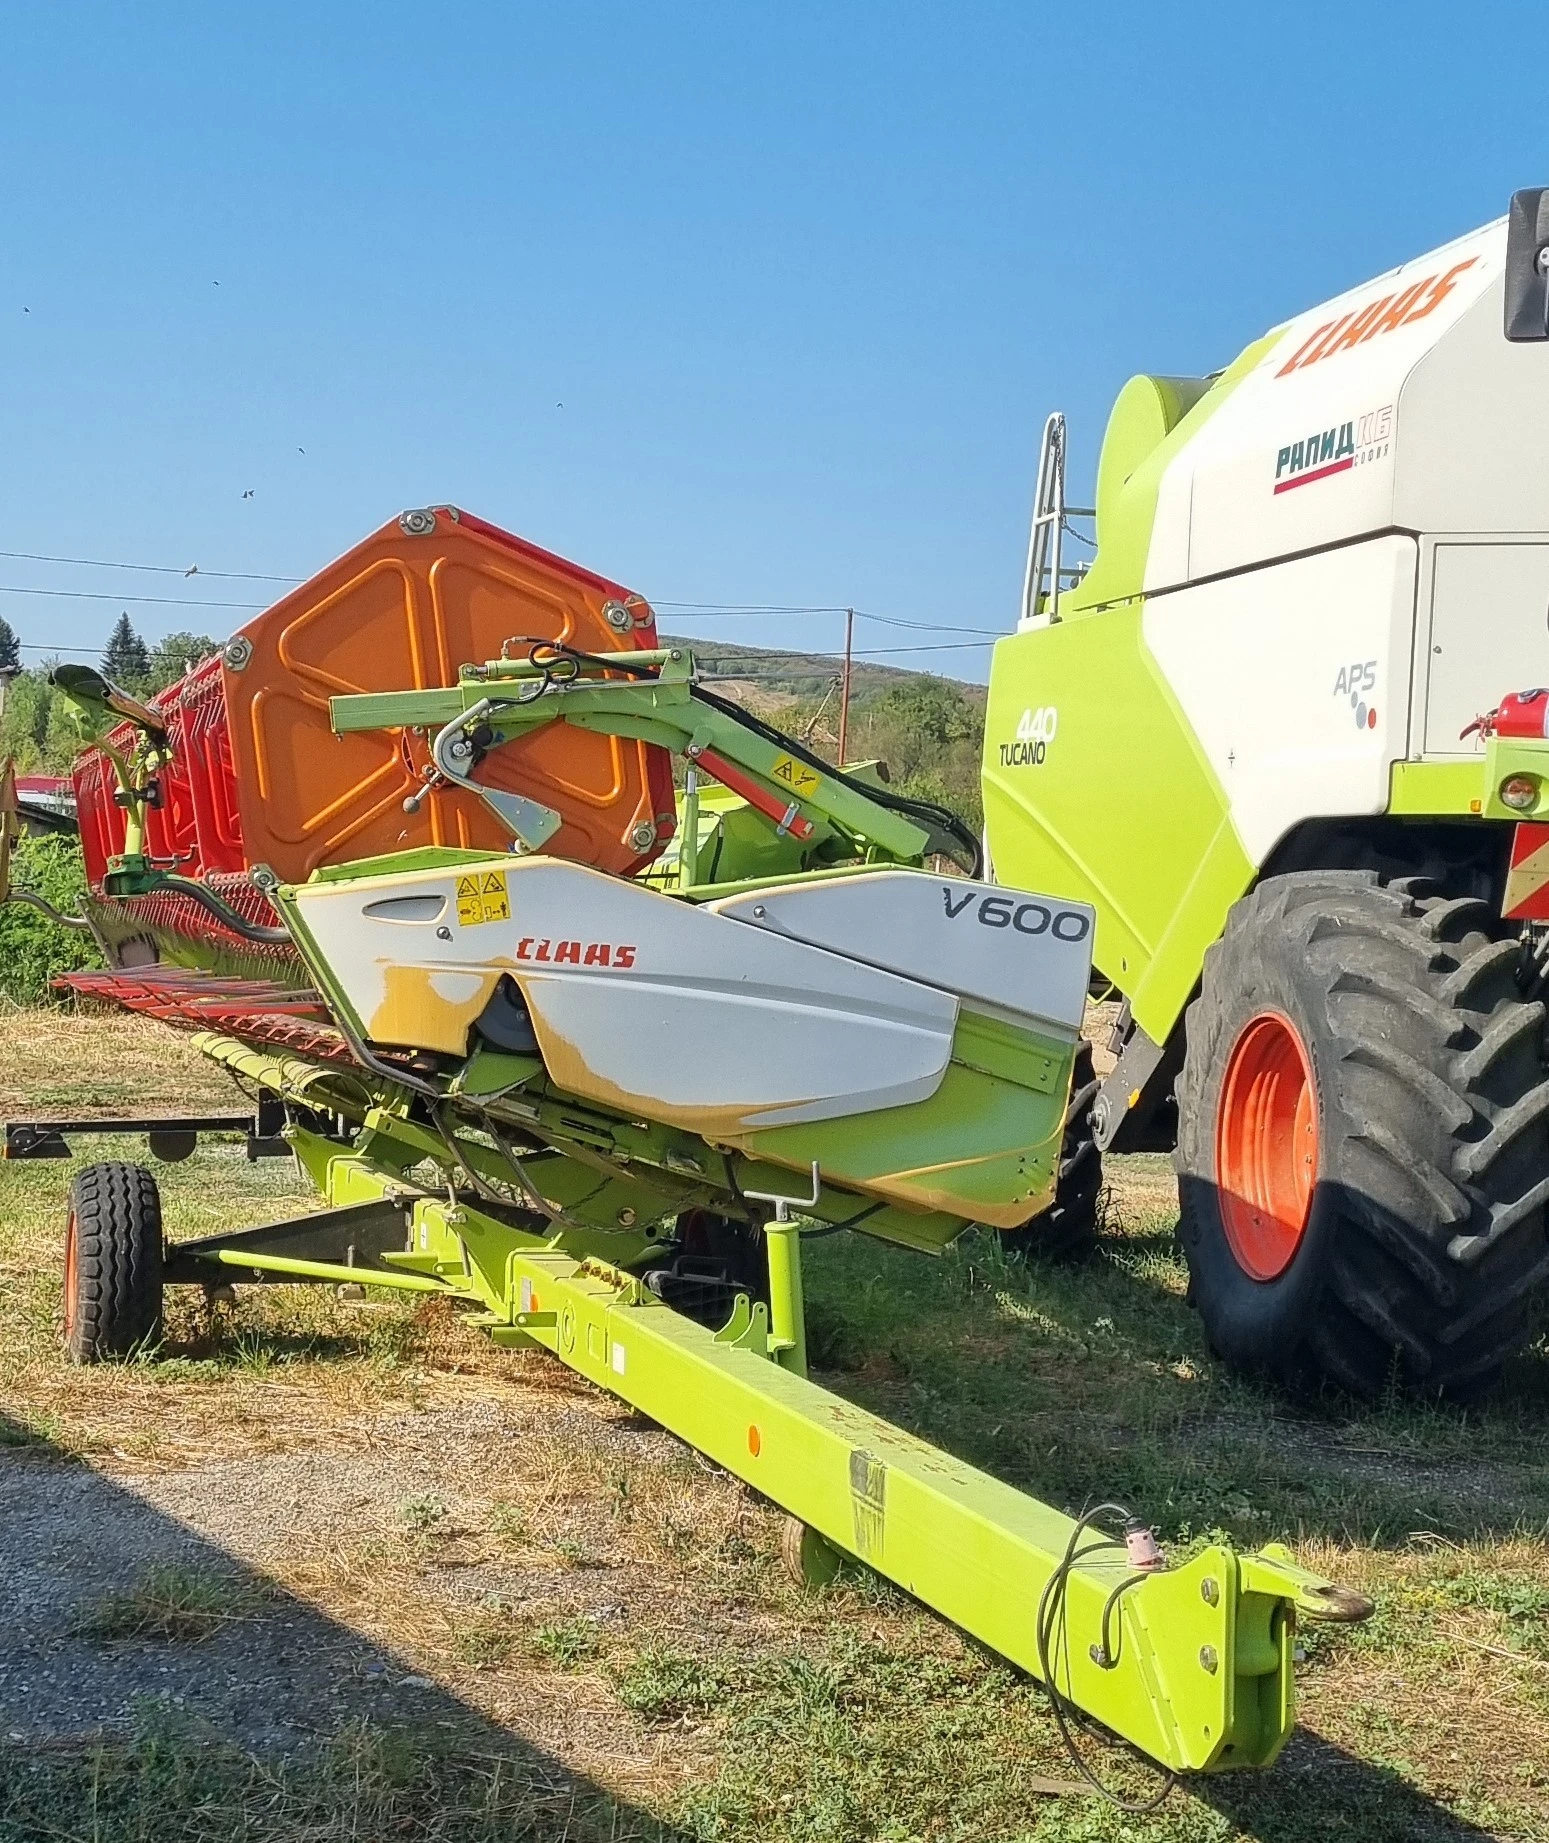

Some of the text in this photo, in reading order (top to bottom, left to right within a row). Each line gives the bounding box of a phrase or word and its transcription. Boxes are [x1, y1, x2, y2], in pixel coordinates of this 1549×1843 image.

[1273, 255, 1482, 380] CLAAS
[1333, 660, 1377, 696] APS
[1016, 706, 1058, 743] 440
[999, 740, 1046, 767] TUCANO
[516, 937, 637, 969] CLAAS
